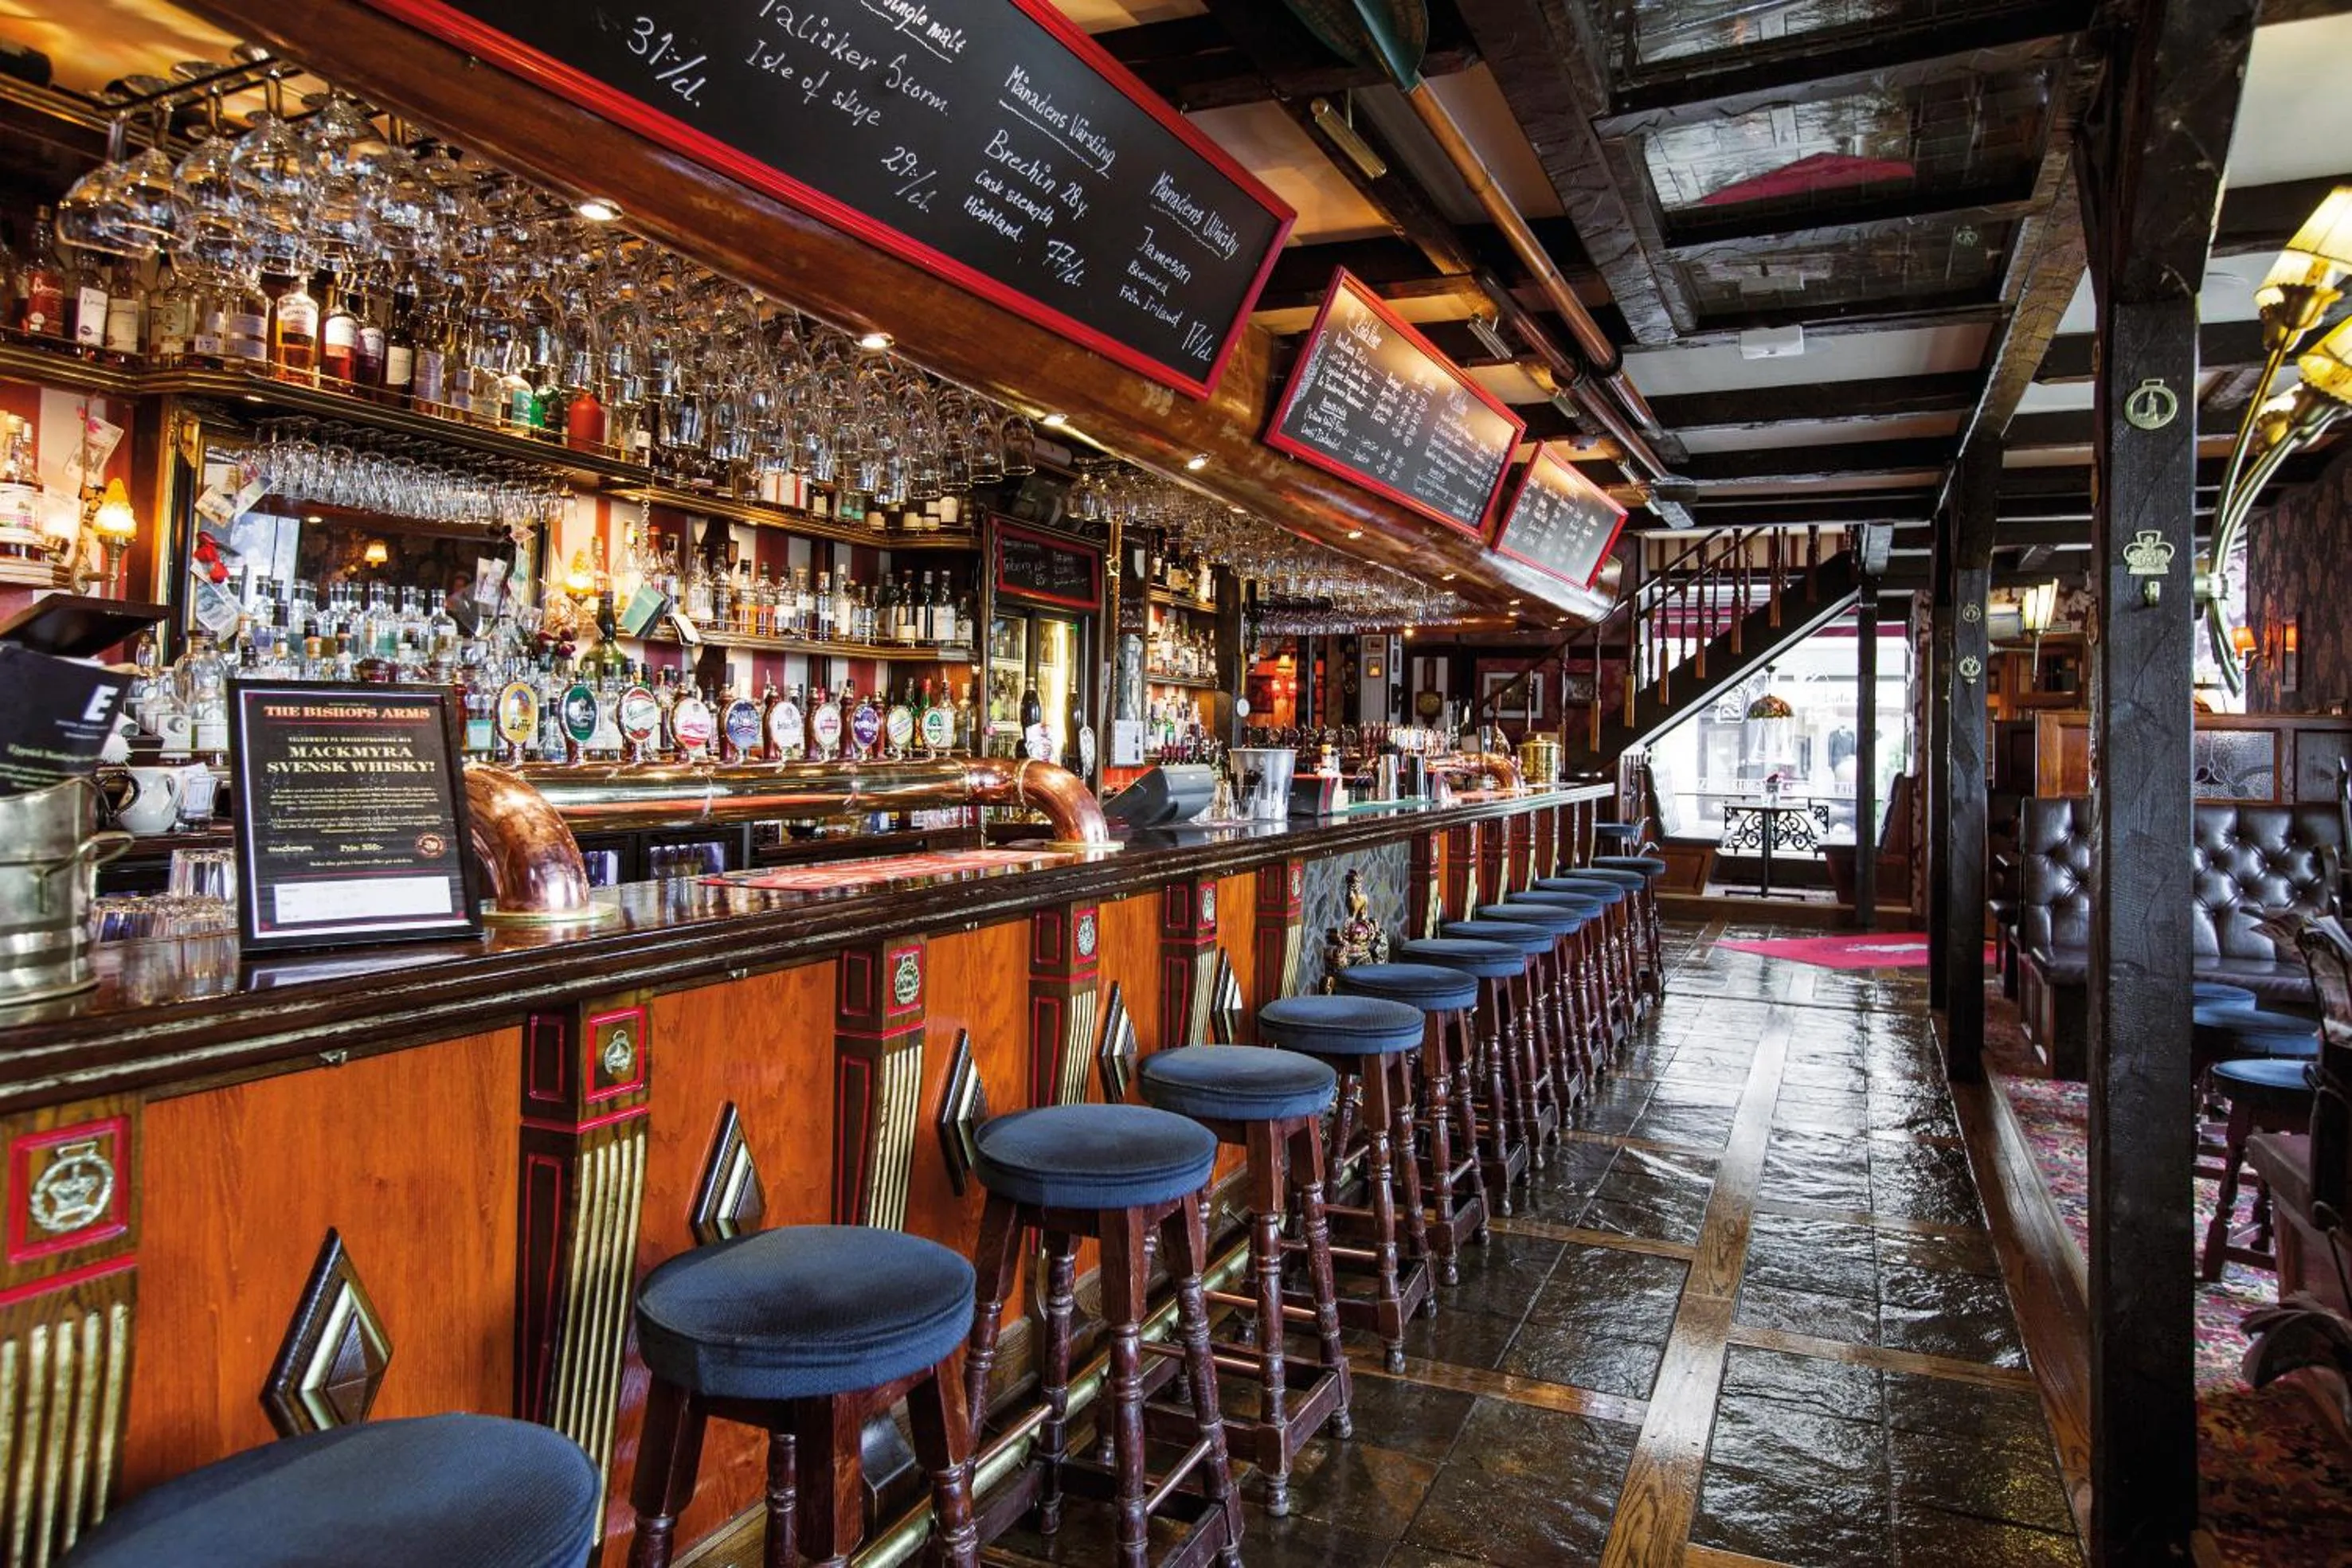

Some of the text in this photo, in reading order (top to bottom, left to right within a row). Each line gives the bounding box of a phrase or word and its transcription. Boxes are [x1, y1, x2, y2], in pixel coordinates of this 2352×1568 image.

[926, 22, 966, 53] malt
[801, 71, 830, 104] of
[1004, 65, 1115, 173] Månadens Värsting
[984, 129, 1056, 194] Brechin
[975, 169, 1004, 195] Cask
[1150, 170, 1239, 260] Månadens Whisky
[1137, 225, 1192, 284] Jameson
[1128, 260, 1169, 297] Blended
[1120, 285, 1183, 328] Från Irland
[263, 706, 431, 719] THE BISHOPS ARMS
[266, 761, 436, 773] SVENSK WHISKY!
[289, 745, 413, 758] MACKMYRA
